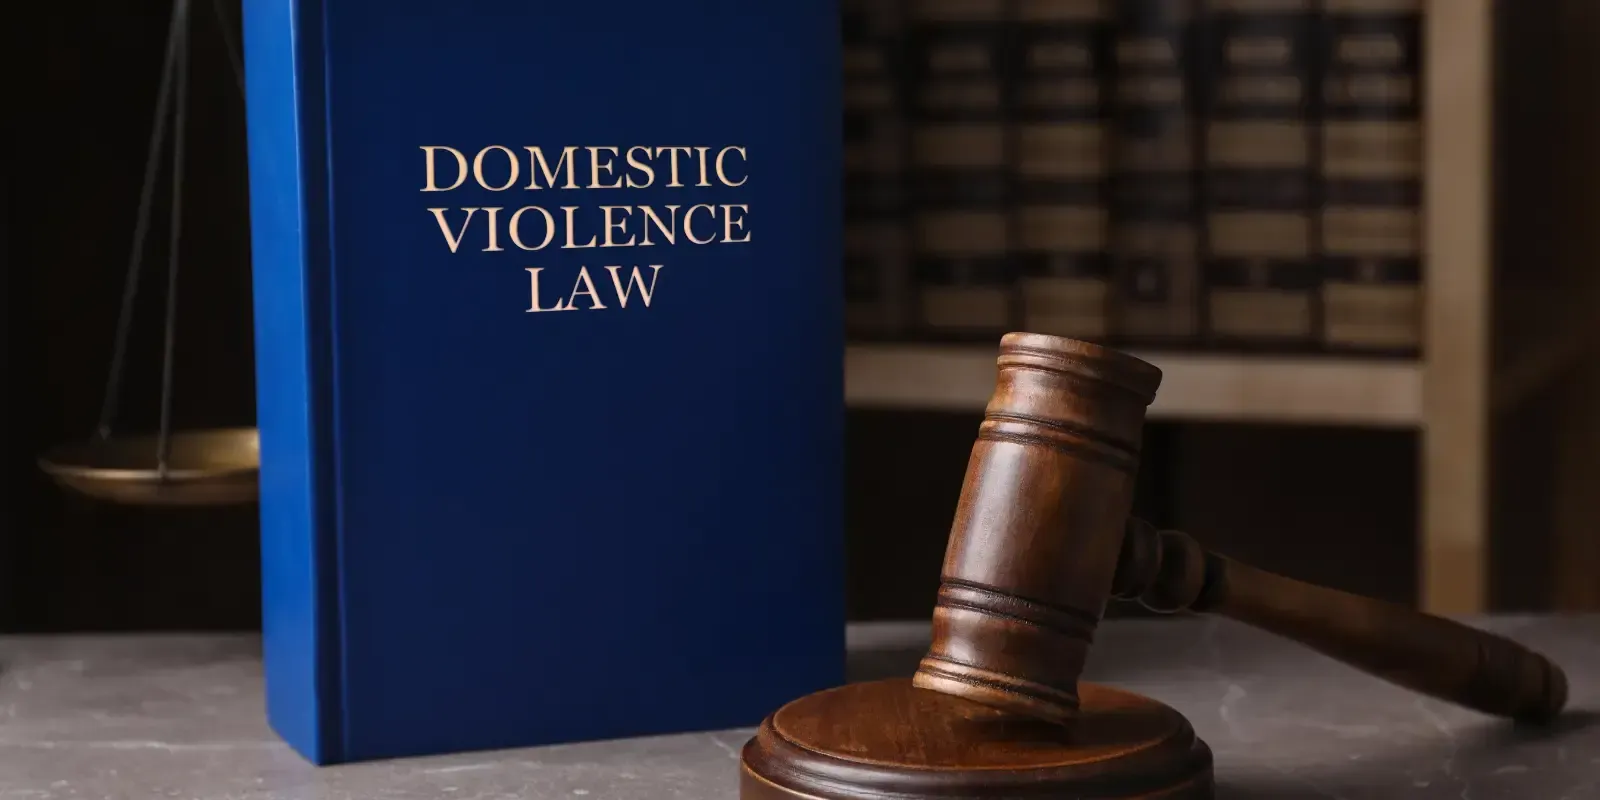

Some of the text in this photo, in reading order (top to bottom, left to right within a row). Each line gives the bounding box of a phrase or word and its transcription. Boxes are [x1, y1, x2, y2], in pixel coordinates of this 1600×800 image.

[420, 145, 749, 192] DOMESTIC
[427, 204, 752, 254] VIOLENCE
[525, 264, 663, 313] LAW
